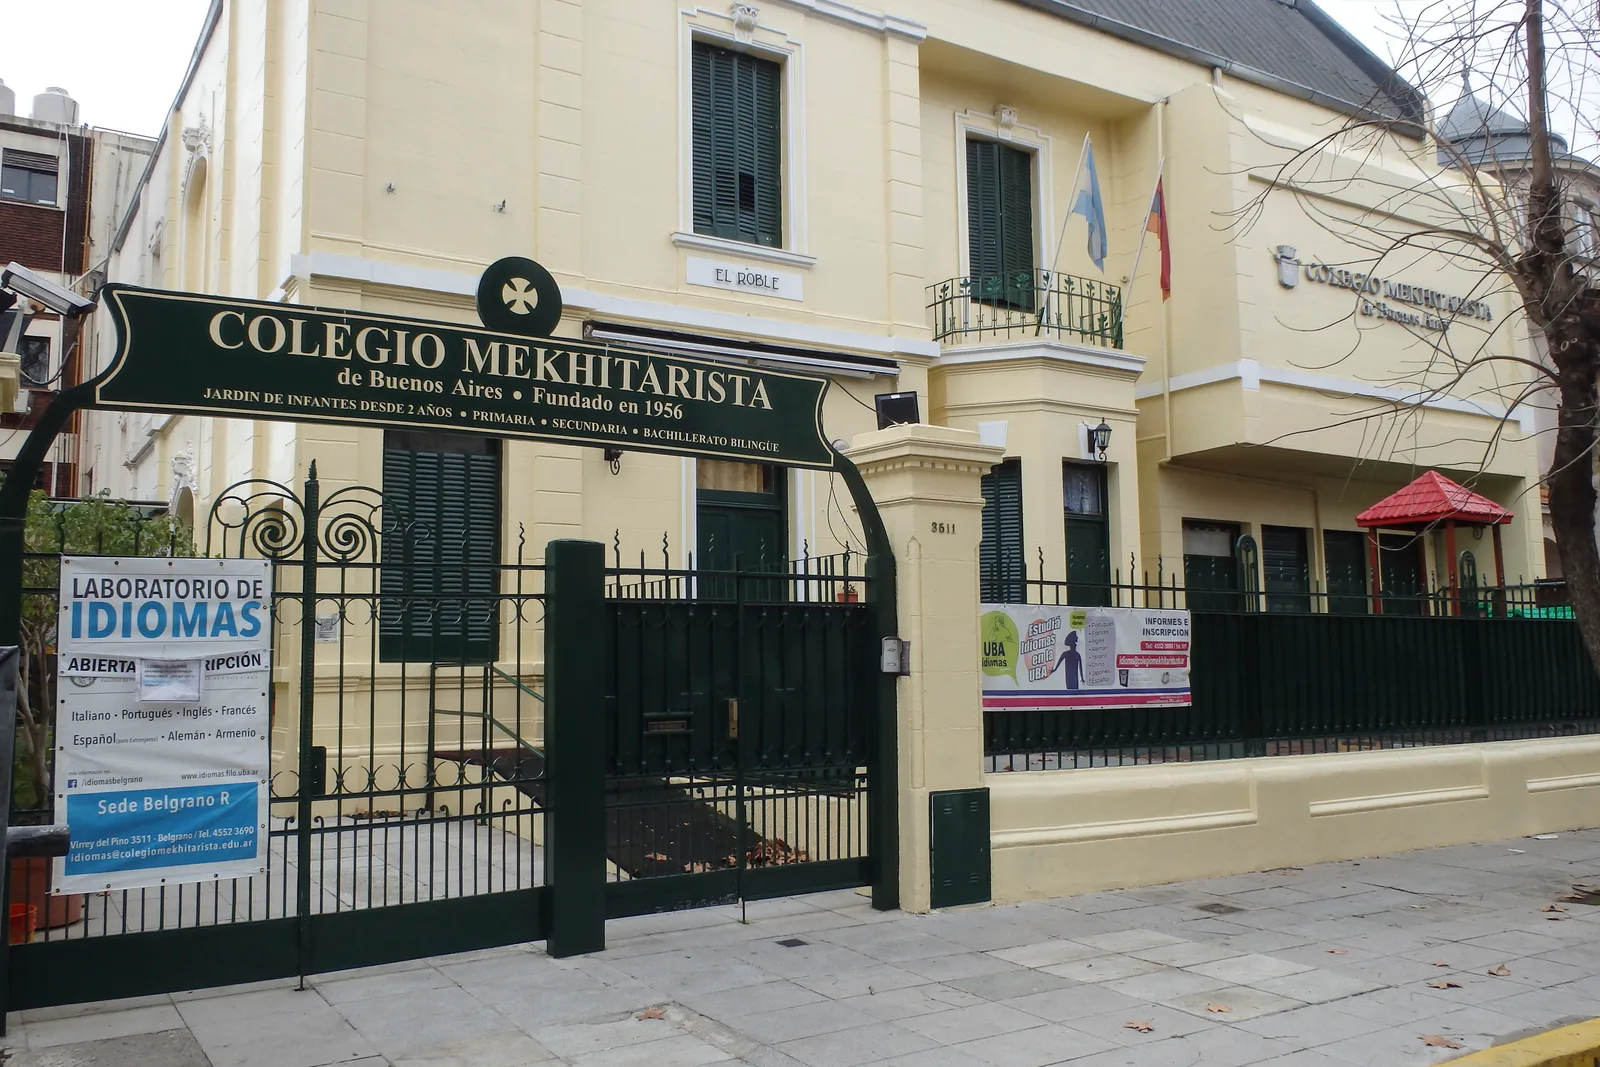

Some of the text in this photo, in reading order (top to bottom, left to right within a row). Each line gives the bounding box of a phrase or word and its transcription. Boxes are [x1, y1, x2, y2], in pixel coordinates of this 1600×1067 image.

[715, 268, 780, 290] EL ROBLE
[209, 310, 774, 410] COLEGIO MEKHITARISTA
[337, 367, 683, 420] de Buenos Aires Fundado en 1956
[203, 387, 260, 403] JARDIN
[264, 392, 284, 405] DE
[288, 394, 357, 410] INFANTES
[360, 400, 405, 415] DESDE
[407, 404, 415, 416] 2
[417, 403, 453, 418] AÑOS
[473, 410, 536, 427] PRIMARIA
[552, 418, 628, 435] SECUNDARIA
[643, 428, 727, 447] BACHILLERATO
[931, 521, 956, 535] 3511
[73, 577, 263, 600] LABORATORIO DE
[71, 601, 262, 639] IDIOMAS
[1145, 617, 1189, 626] INFORMES E
[1142, 628, 1189, 636] INSCRIPCION
[984, 641, 1005, 657] UBA
[68, 657, 137, 673] ABIERTA
[981, 657, 1007, 667] idiomas
[1032, 652, 1044, 666] en
[1028, 665, 1048, 682] UBA
[72, 705, 256, 723] Italiano Portugués Inglés Francés
[73, 733, 116, 748] Español
[168, 730, 205, 742] Alemán
[216, 728, 256, 739] Armenio
[82, 777, 143, 787] /idiomasbelgrano
[181, 769, 258, 780] www.idiomas.filo.uba.ar
[98, 791, 230, 815] Sede Belgrano R
[70, 840, 95, 850] Virrey
[96, 838, 109, 847] del
[111, 837, 129, 846] Pino
[130, 835, 151, 844] 3511
[158, 832, 193, 843] Belgrano
[198, 830, 211, 839] Tel.
[212, 828, 232, 837] 4552
[234, 826, 254, 836] 3690
[70, 840, 252, 862] idiomas@colegiomekhitarista.edu.ar
